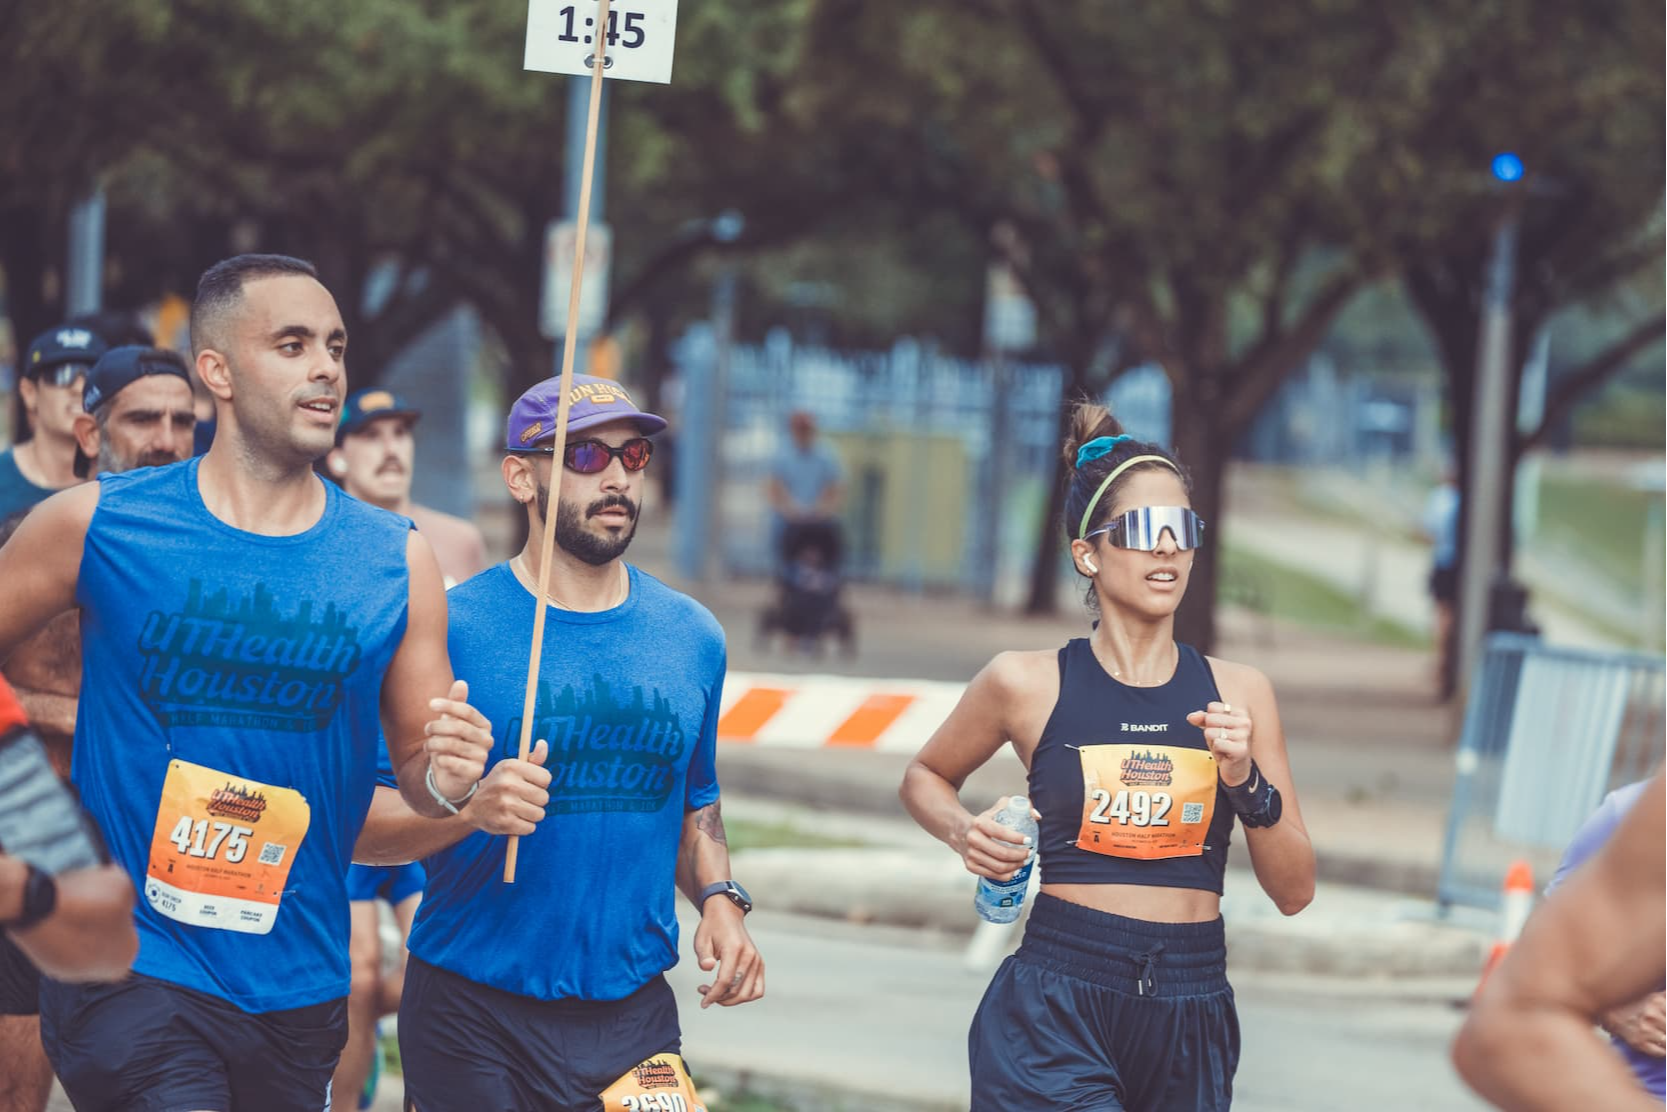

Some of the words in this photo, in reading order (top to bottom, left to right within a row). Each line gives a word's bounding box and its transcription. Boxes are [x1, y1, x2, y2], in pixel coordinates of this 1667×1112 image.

[558, 5, 645, 48] 1:45
[568, 385, 594, 406] UN
[138, 609, 359, 675] UTHealth
[139, 653, 341, 710] Houston
[1130, 723, 1169, 732] BANDIT
[549, 755, 668, 791] ouston
[1120, 758, 1173, 772] UTHealth
[1120, 769, 1169, 781] Houston
[1090, 788, 1172, 826] 2492
[170, 815, 254, 864] 4175
[621, 1091, 688, 1112] 3690
